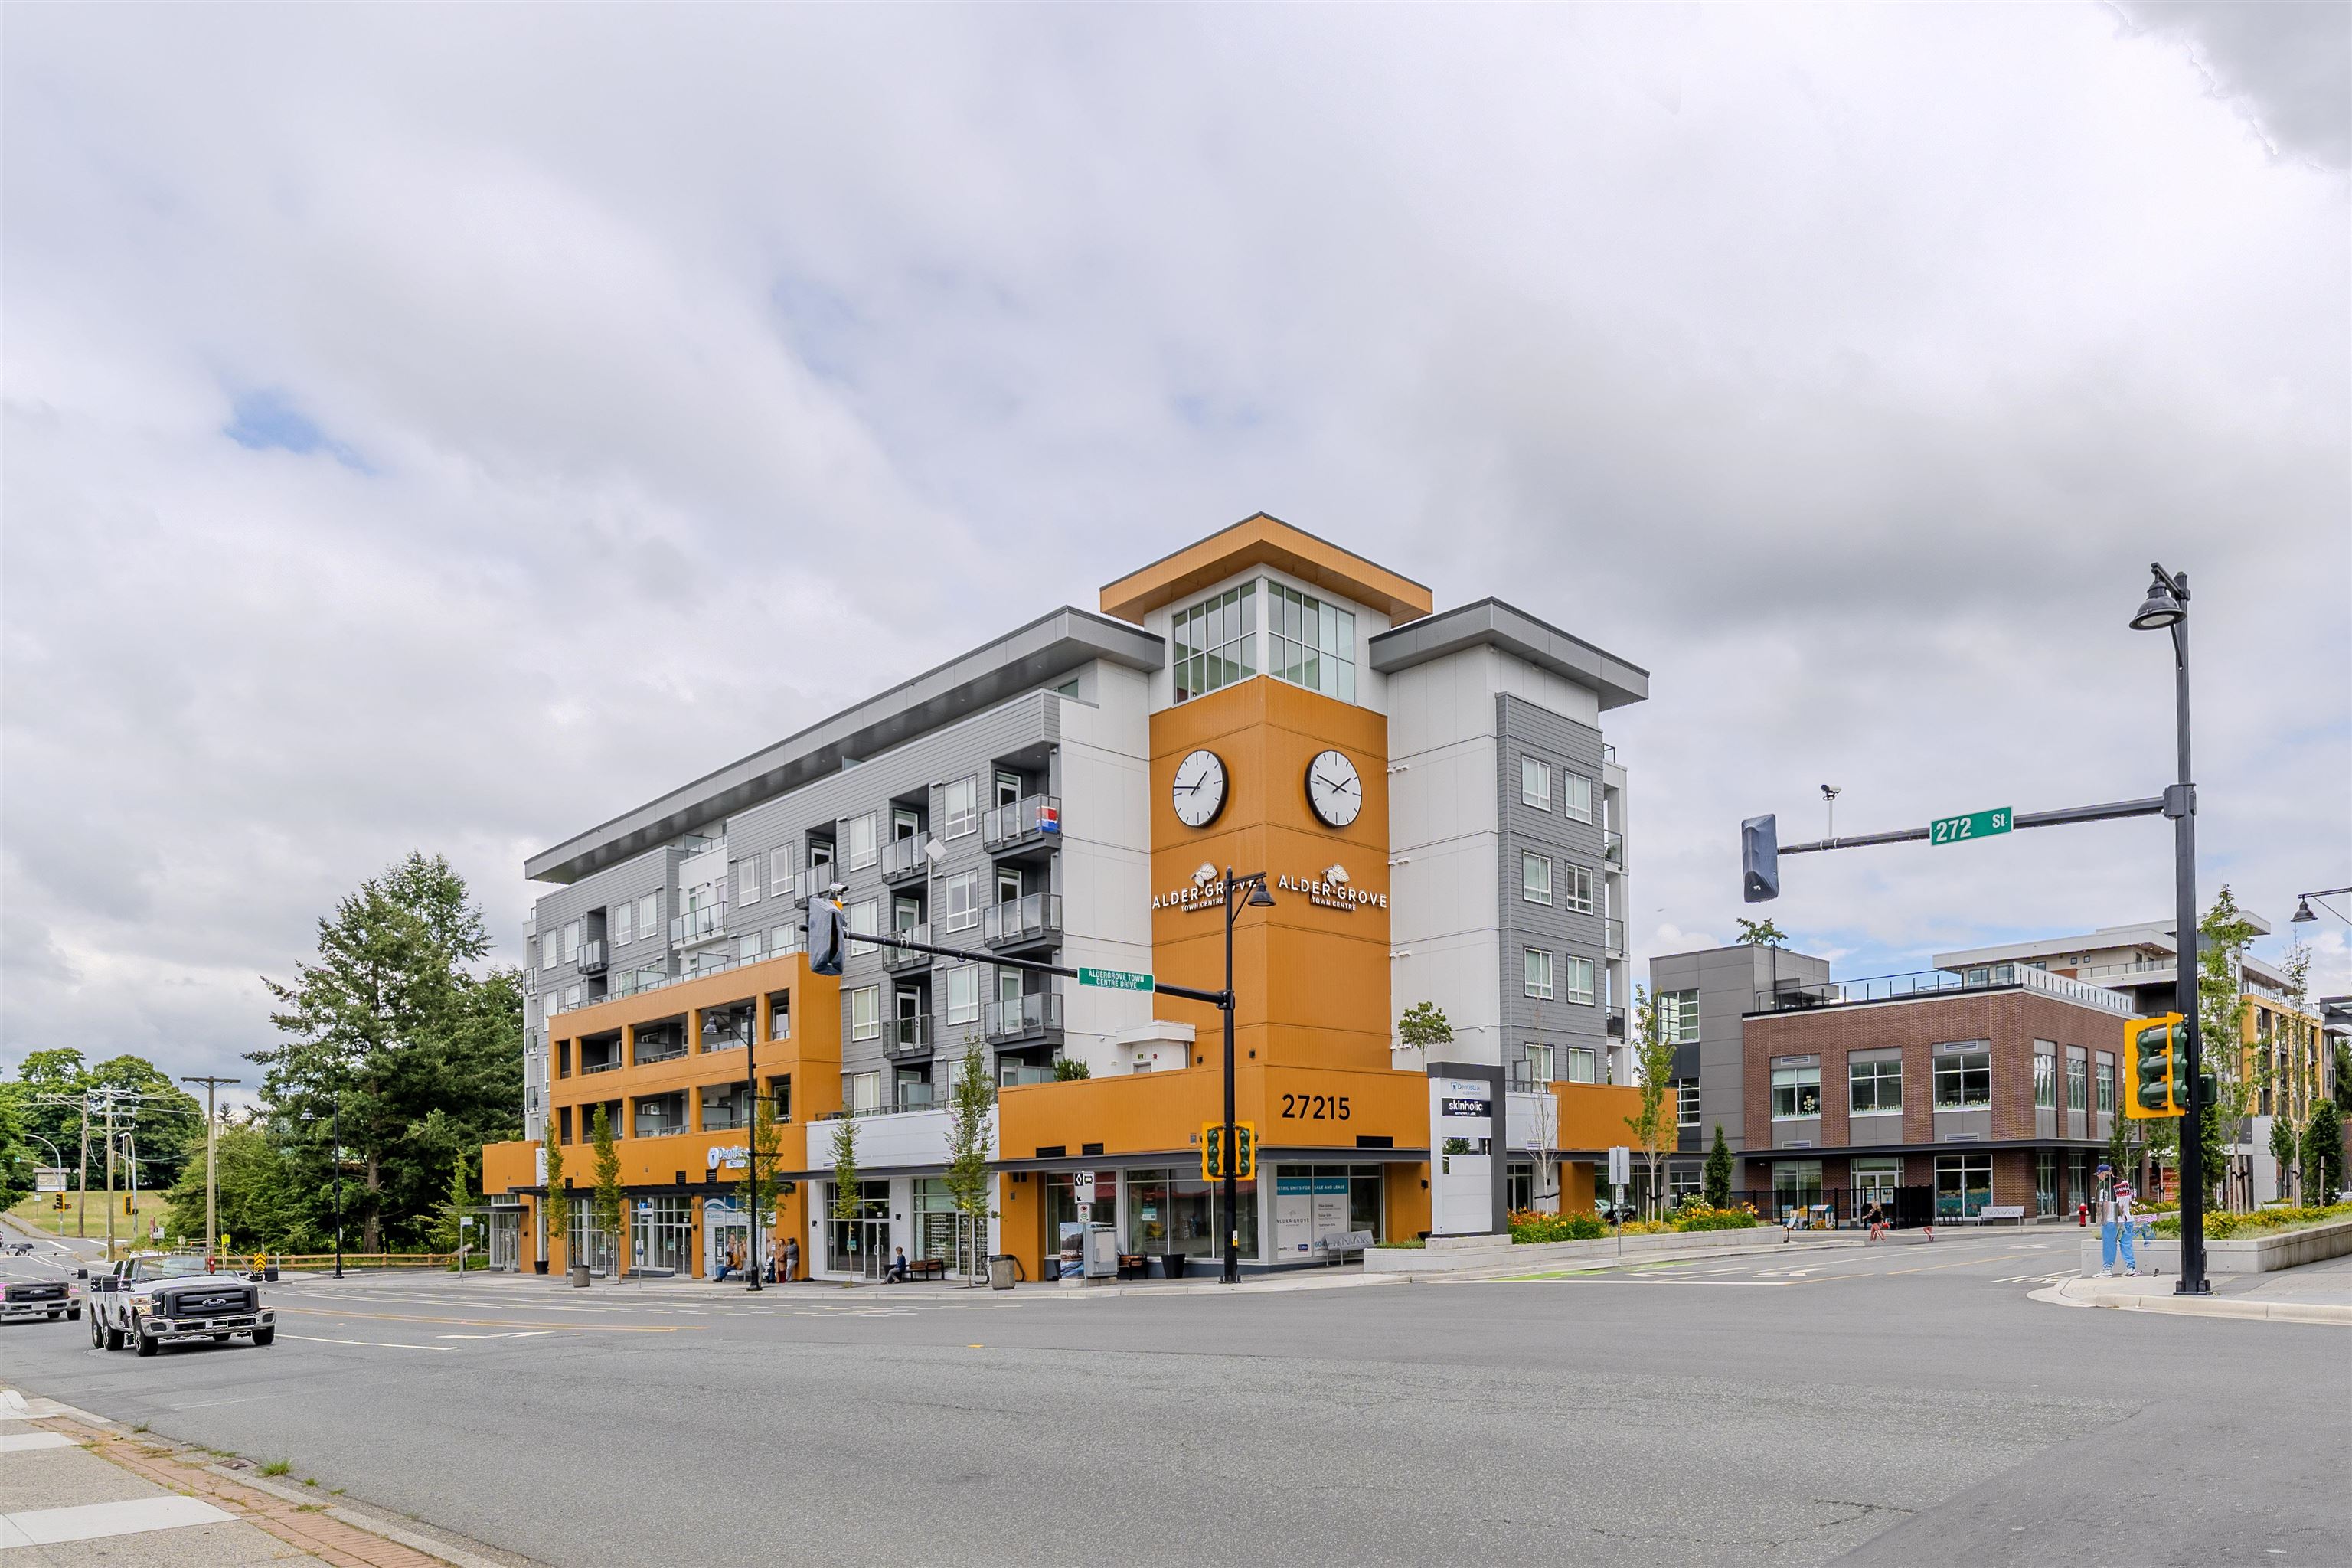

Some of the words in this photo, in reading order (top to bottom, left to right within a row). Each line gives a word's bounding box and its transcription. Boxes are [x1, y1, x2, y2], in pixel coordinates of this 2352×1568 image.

[1936, 817, 1971, 842] 272
[1181, 901, 1199, 913] TOWN
[1200, 897, 1224, 908] CENTRE
[1311, 895, 1331, 906] TOWN
[1332, 898, 1357, 912] CENTRE
[1088, 969, 1126, 981] ALDERGROVE
[1128, 973, 1145, 982] TOWN
[1096, 978, 1119, 987] CENTRE
[1119, 980, 1138, 989] DRIVE
[1282, 1093, 1351, 1121] 27215
[1449, 1099, 1484, 1111] skinholic
